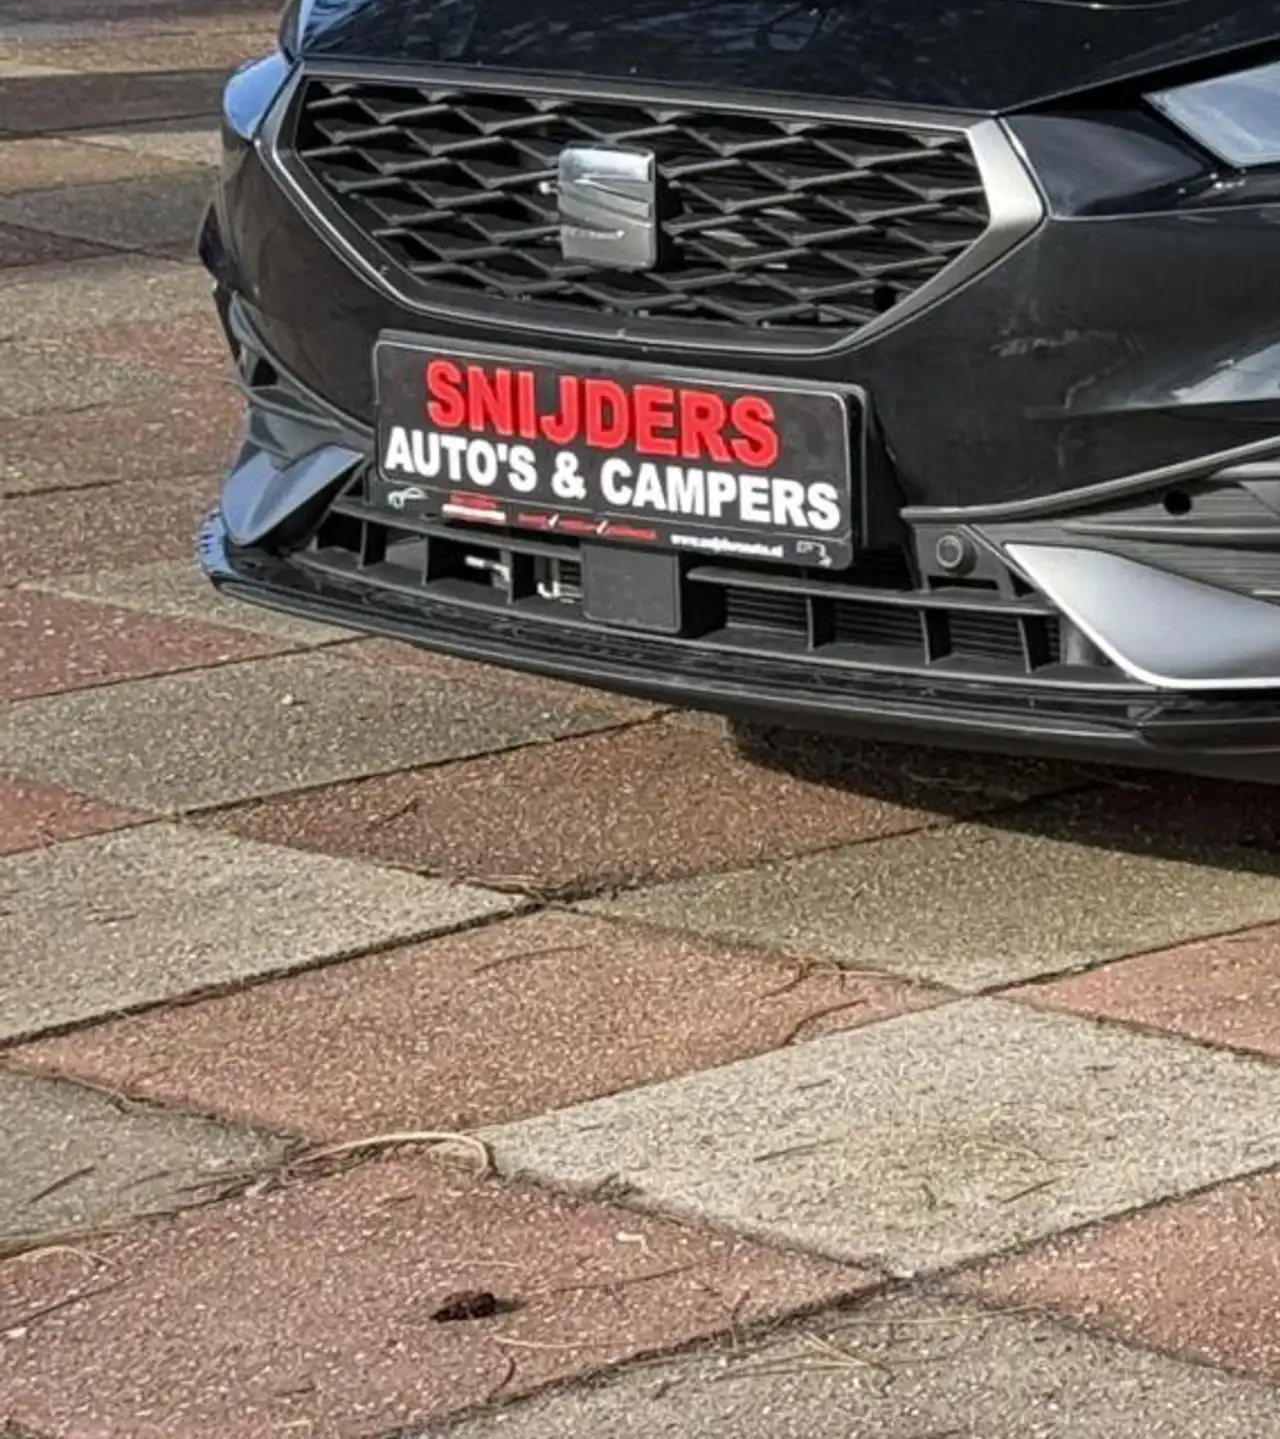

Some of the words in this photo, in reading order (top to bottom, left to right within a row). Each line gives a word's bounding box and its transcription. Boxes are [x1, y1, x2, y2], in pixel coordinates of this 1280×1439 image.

[427, 359, 780, 469] SNIJDERS
[384, 425, 538, 493] AUTO'S
[551, 450, 587, 500] &
[601, 457, 841, 531] CAMPERS
